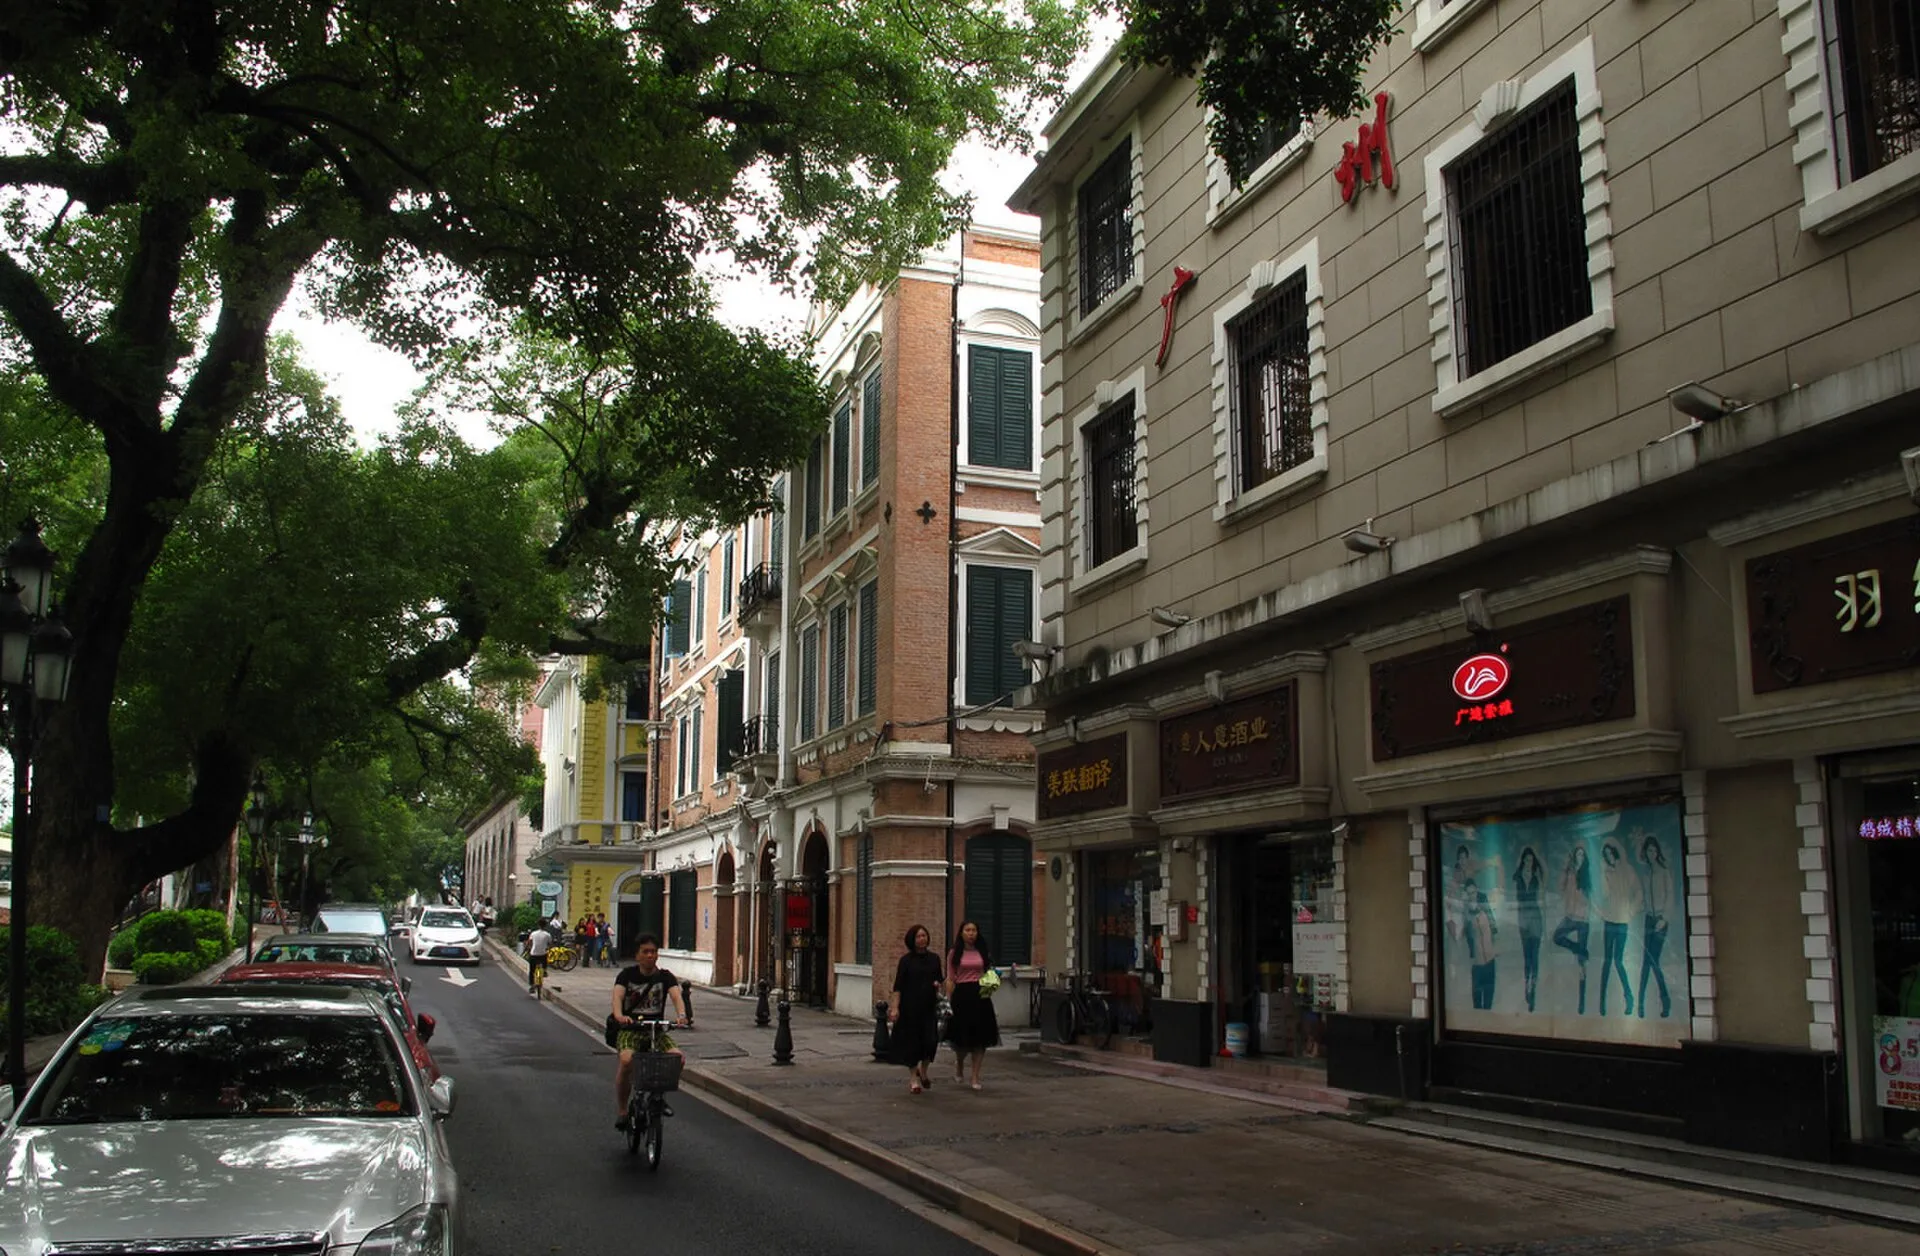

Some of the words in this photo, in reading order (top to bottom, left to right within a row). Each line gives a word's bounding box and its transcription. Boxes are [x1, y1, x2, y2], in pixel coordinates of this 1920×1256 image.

[1833, 557, 1920, 633] 羽
[1047, 758, 1113, 800] 美联翻译
